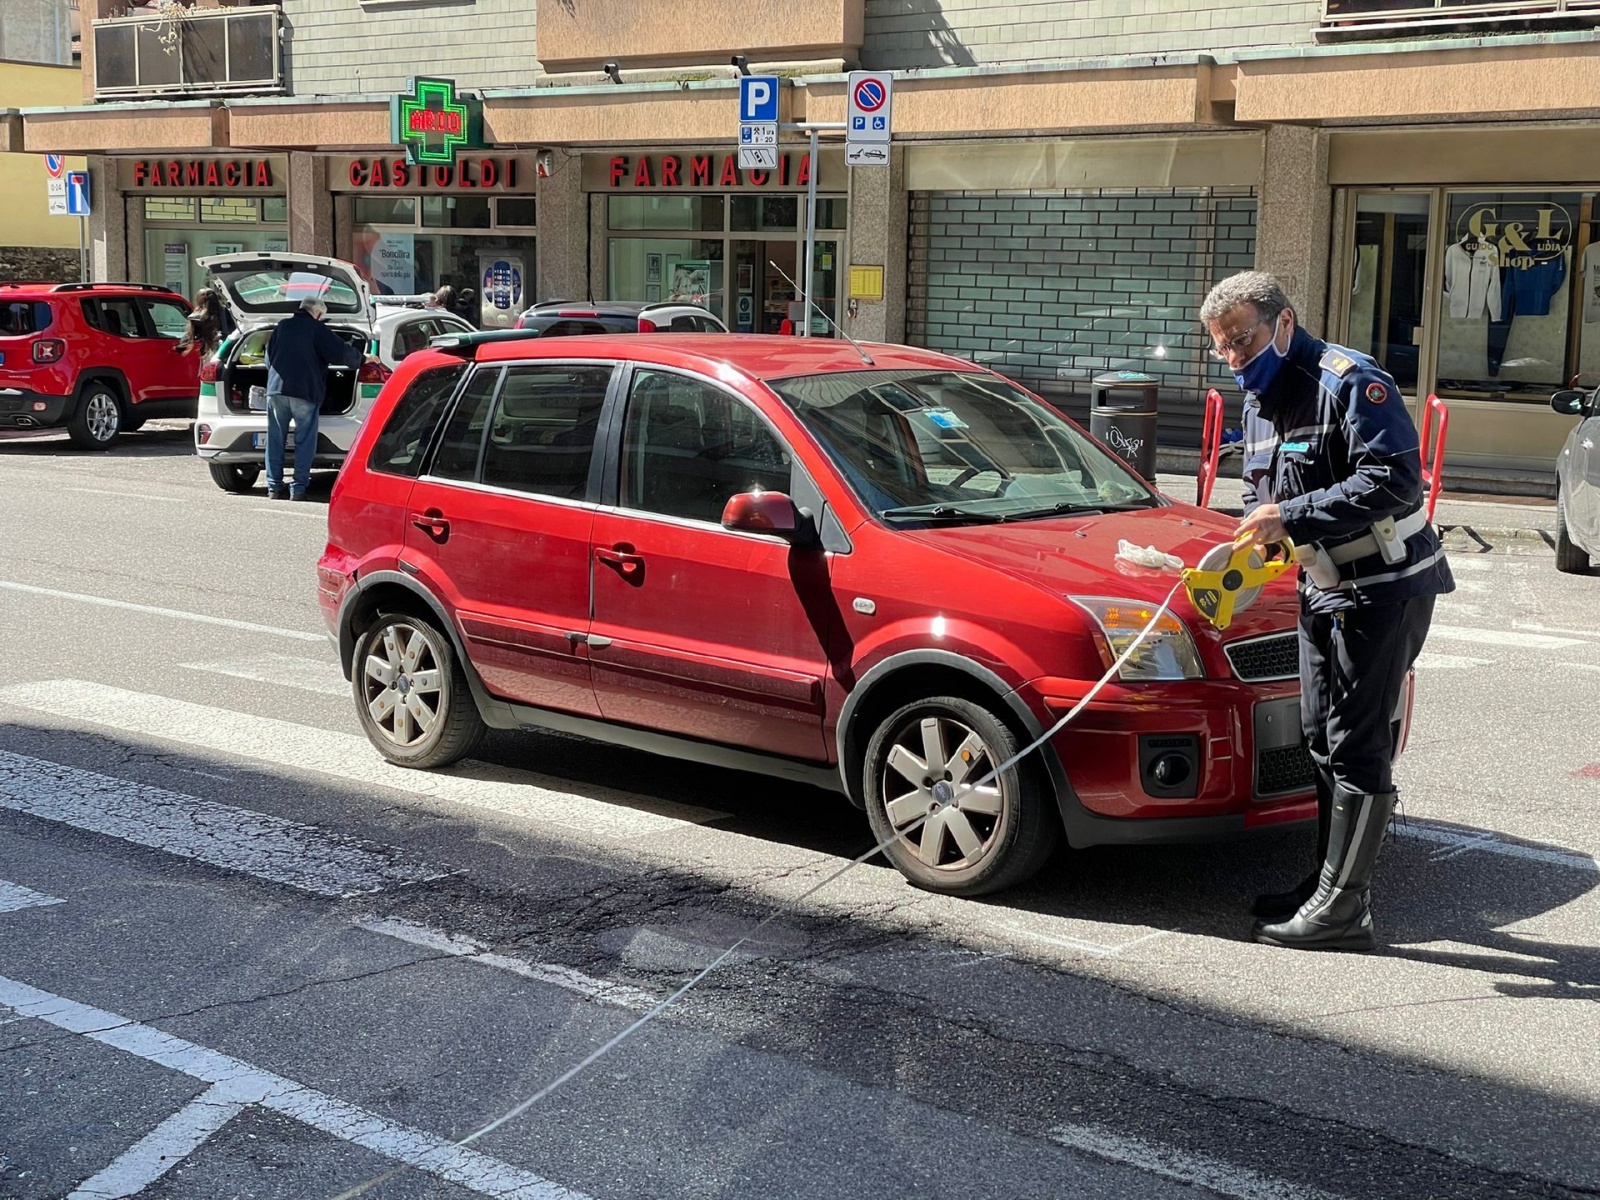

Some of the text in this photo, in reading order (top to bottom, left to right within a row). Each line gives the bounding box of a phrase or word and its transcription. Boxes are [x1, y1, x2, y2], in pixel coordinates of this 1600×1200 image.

[747, 81, 770, 117] P
[855, 117, 864, 129] P
[134, 161, 272, 187] FARMACIA
[1537, 242, 1561, 251] LIDIA
